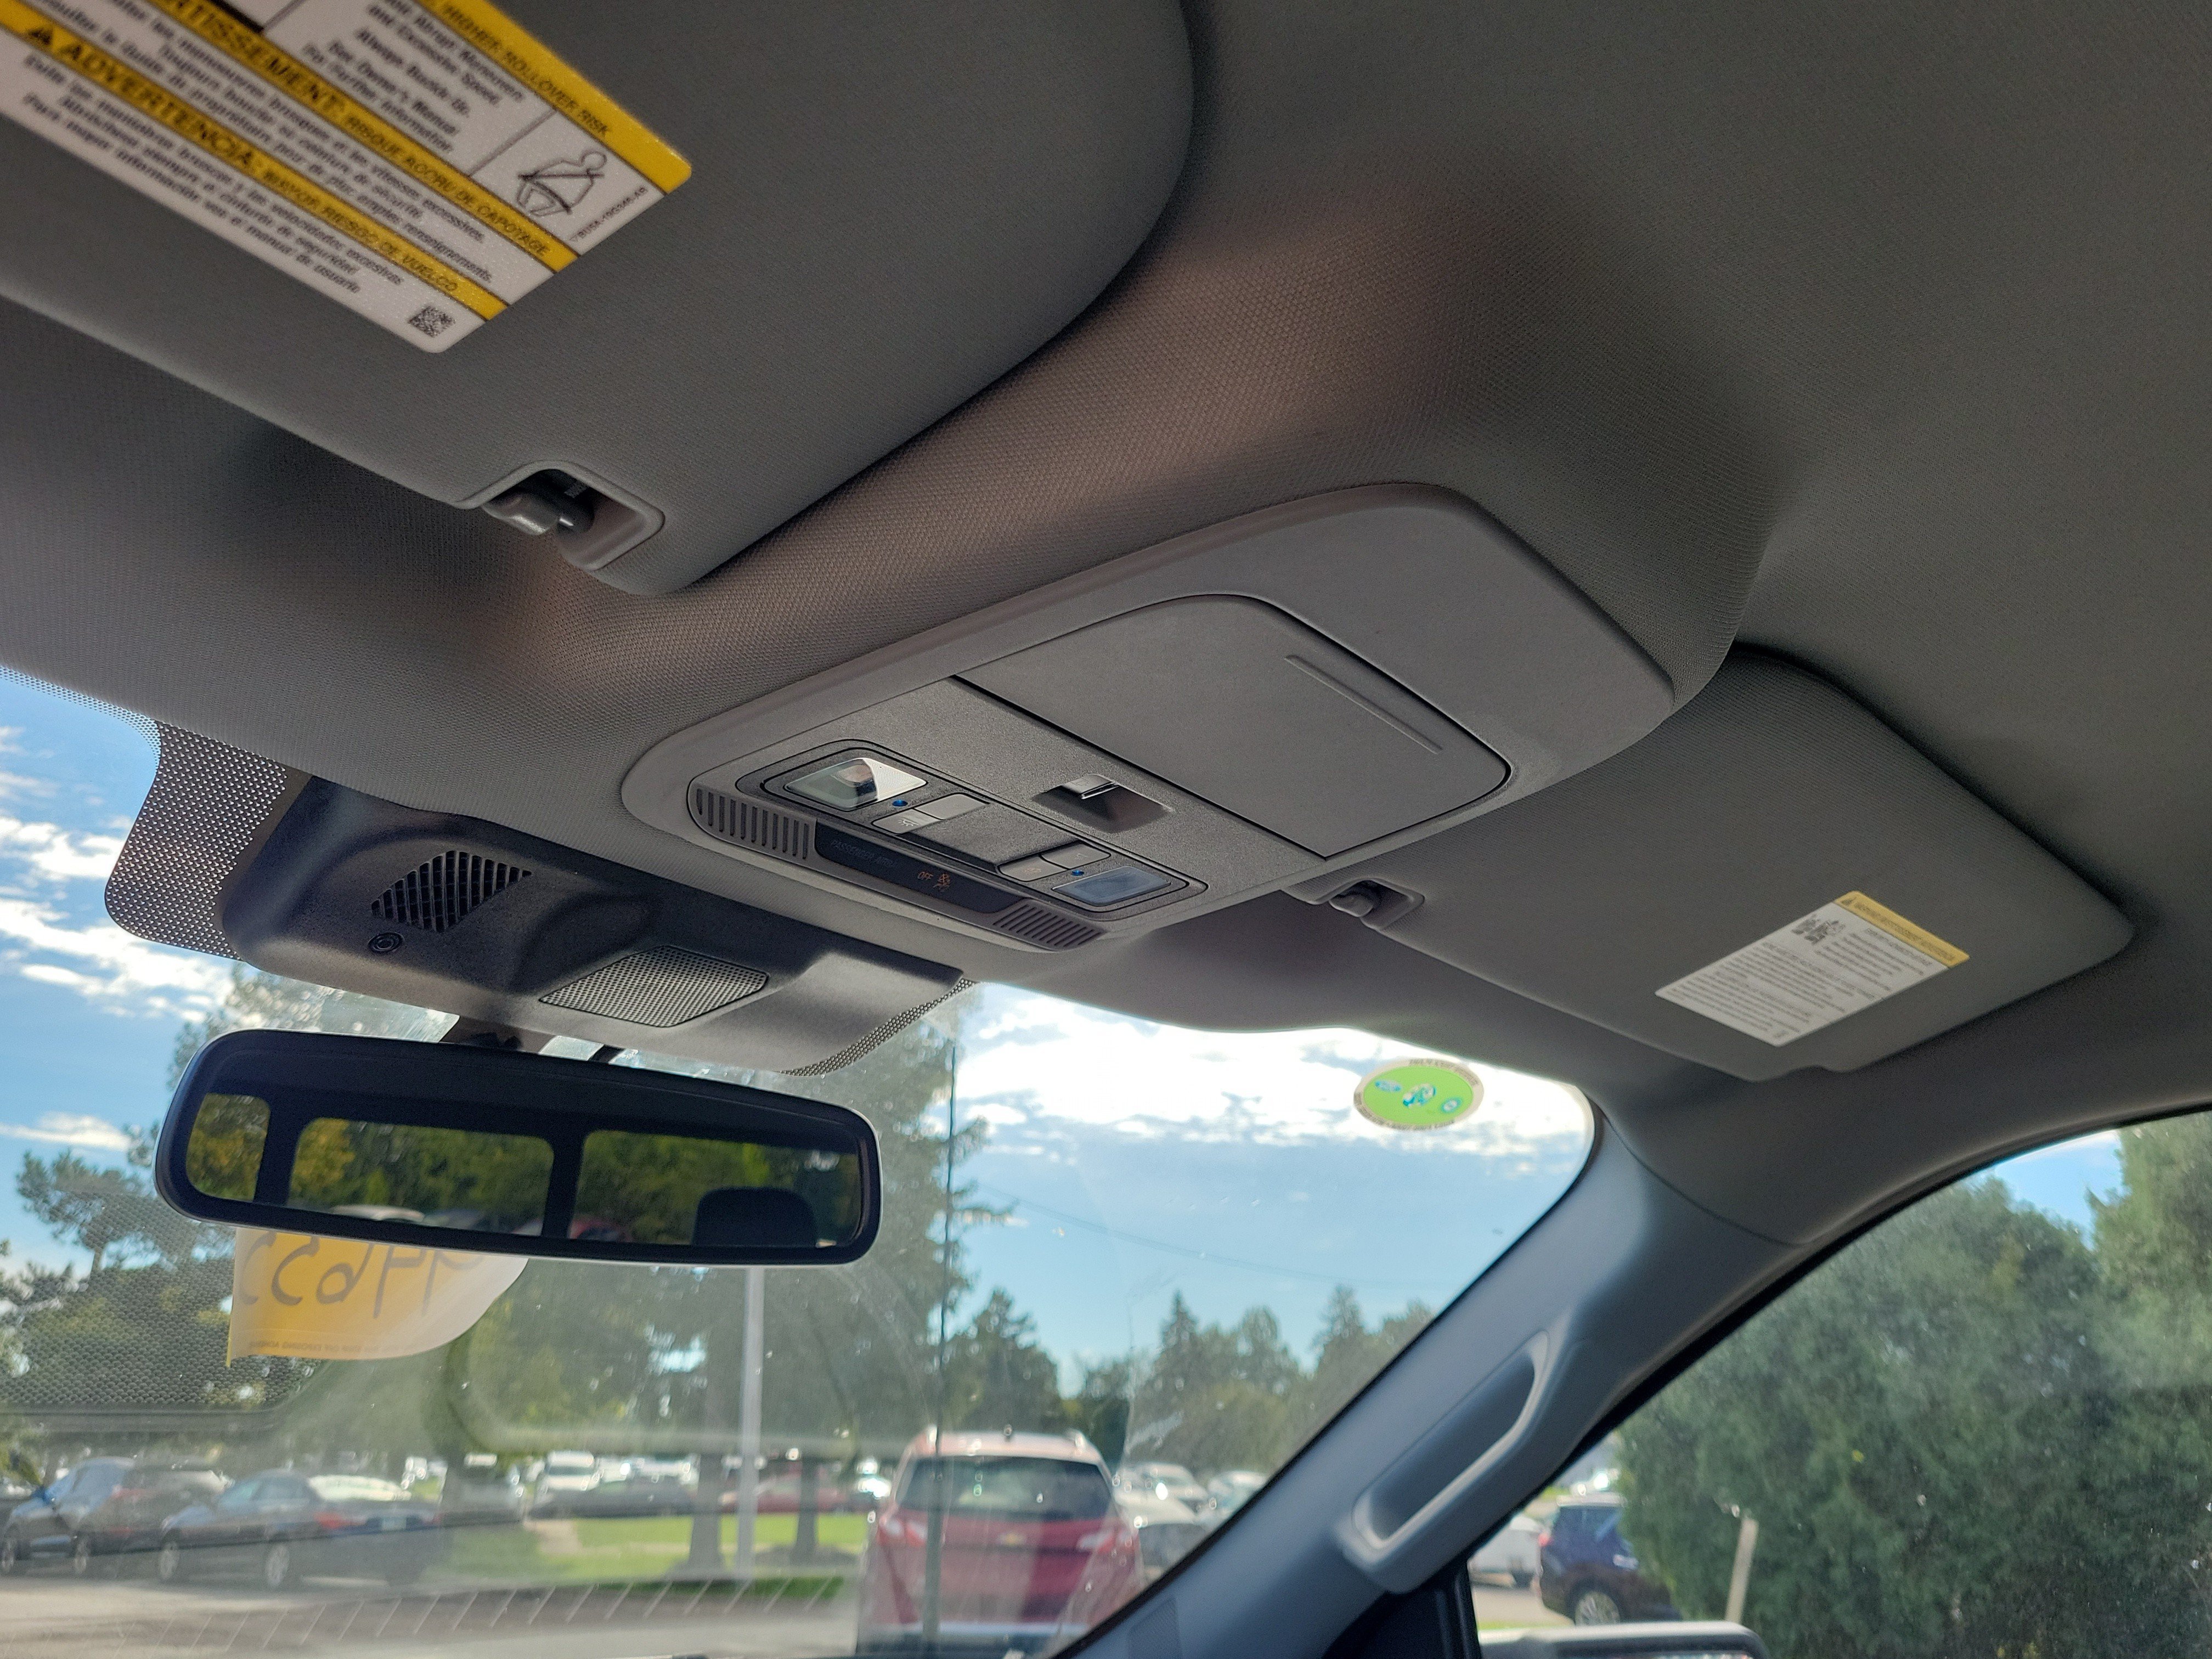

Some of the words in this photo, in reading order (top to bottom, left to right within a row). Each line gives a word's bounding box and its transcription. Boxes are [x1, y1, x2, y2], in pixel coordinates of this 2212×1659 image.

[502, 52, 580, 111] ROLLOVER
[577, 109, 613, 137] RISK
[343, 116, 403, 159] RISQUE
[402, 154, 459, 195] ACCRU
[453, 189, 478, 207] DE
[476, 203, 552, 257] CAPOTAGE
[319, 205, 379, 244] RIESGO
[400, 254, 460, 292] VUELCO
[830, 839, 875, 862] PASSENGER
[917, 871, 933, 881] OFF
